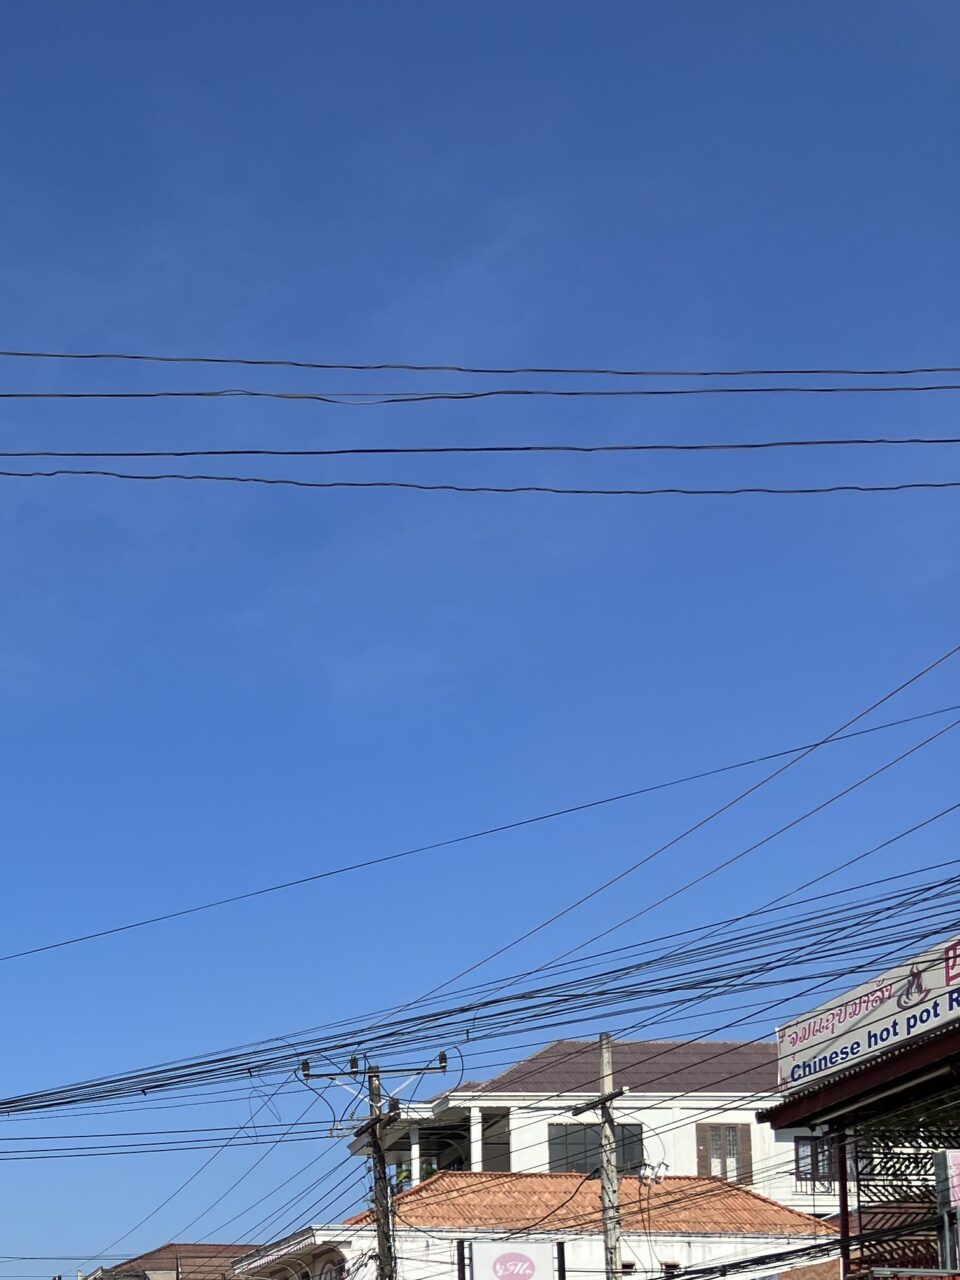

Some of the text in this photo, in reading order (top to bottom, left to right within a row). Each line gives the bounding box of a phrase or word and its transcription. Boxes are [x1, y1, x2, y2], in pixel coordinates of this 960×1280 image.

[790, 1040, 861, 1083] Chinese
[867, 1019, 900, 1049] hot
[906, 1000, 941, 1036] pot
